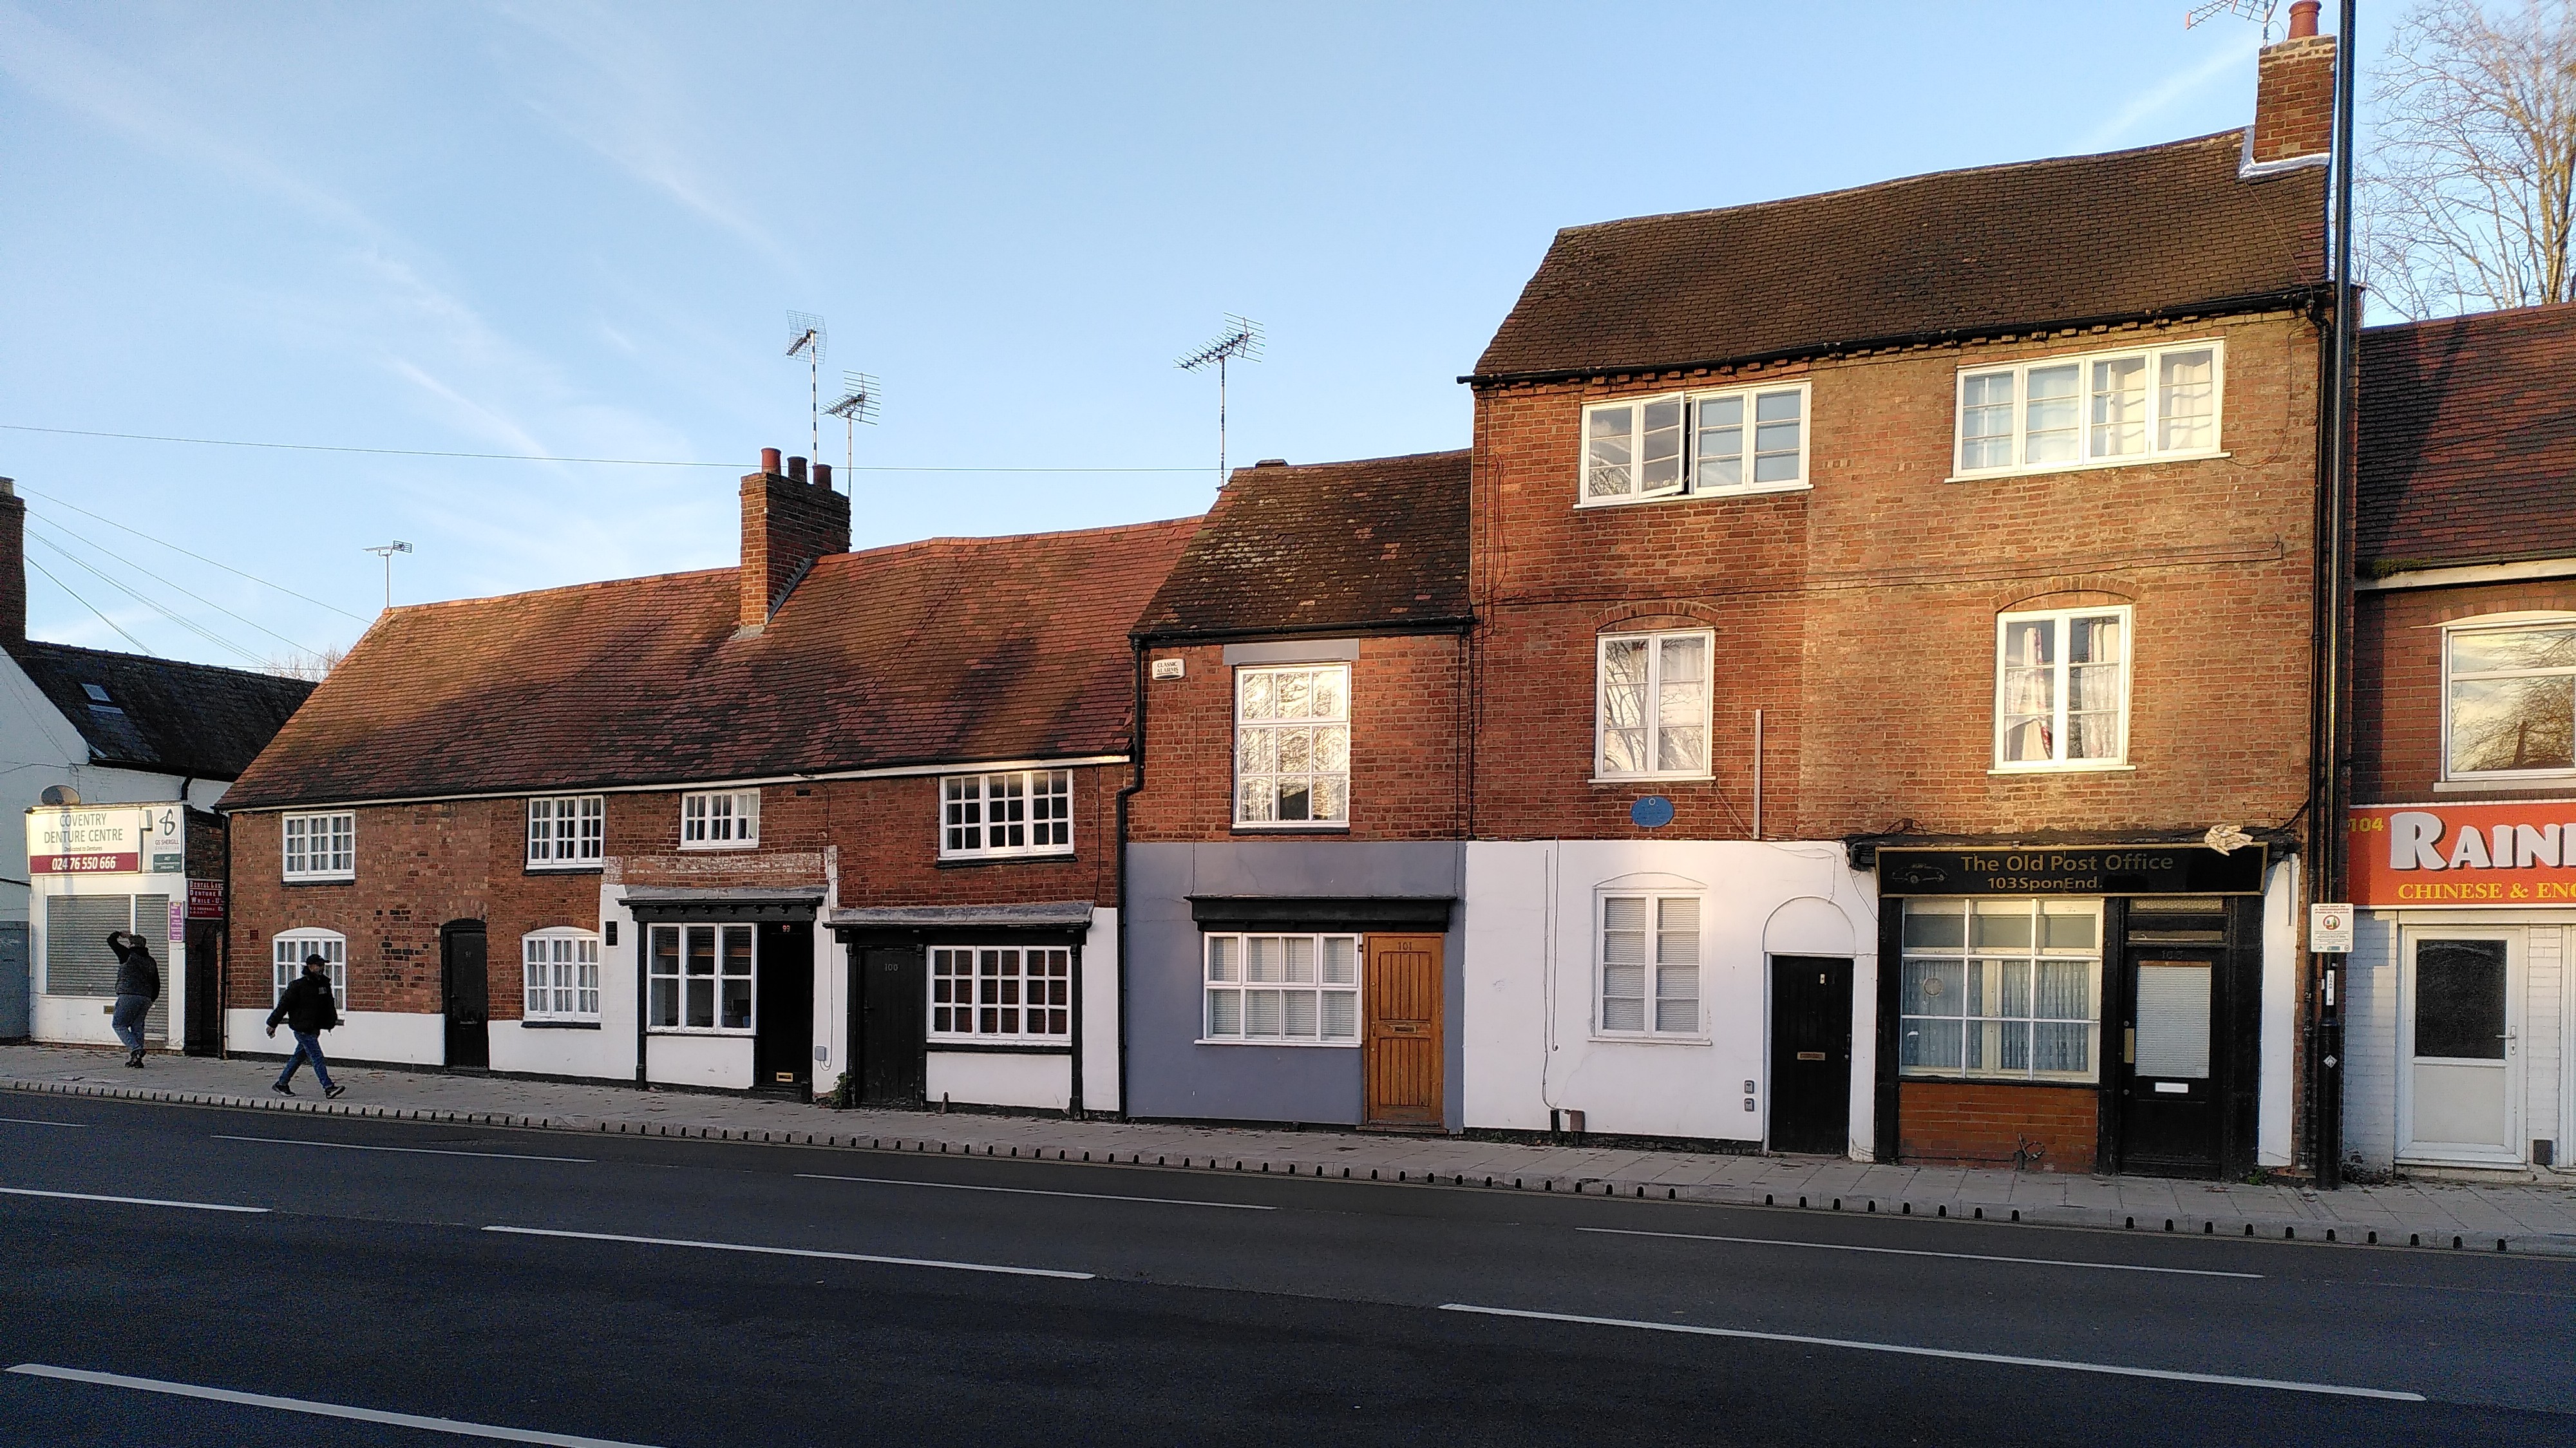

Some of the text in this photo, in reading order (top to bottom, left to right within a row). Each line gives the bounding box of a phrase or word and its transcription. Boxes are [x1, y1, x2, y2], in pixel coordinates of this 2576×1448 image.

[60, 813, 106, 827] COVENTRY
[2349, 817, 2383, 832] 104
[44, 829, 123, 843] DENTURE CENTRE
[52, 856, 116, 870] 024 76 550 666
[1961, 853, 2174, 871] The Old Post Office
[2398, 883, 2503, 899] CHINESE
[2510, 883, 2529, 899] &
[1397, 942, 1412, 950] 101
[885, 963, 898, 972] 100
